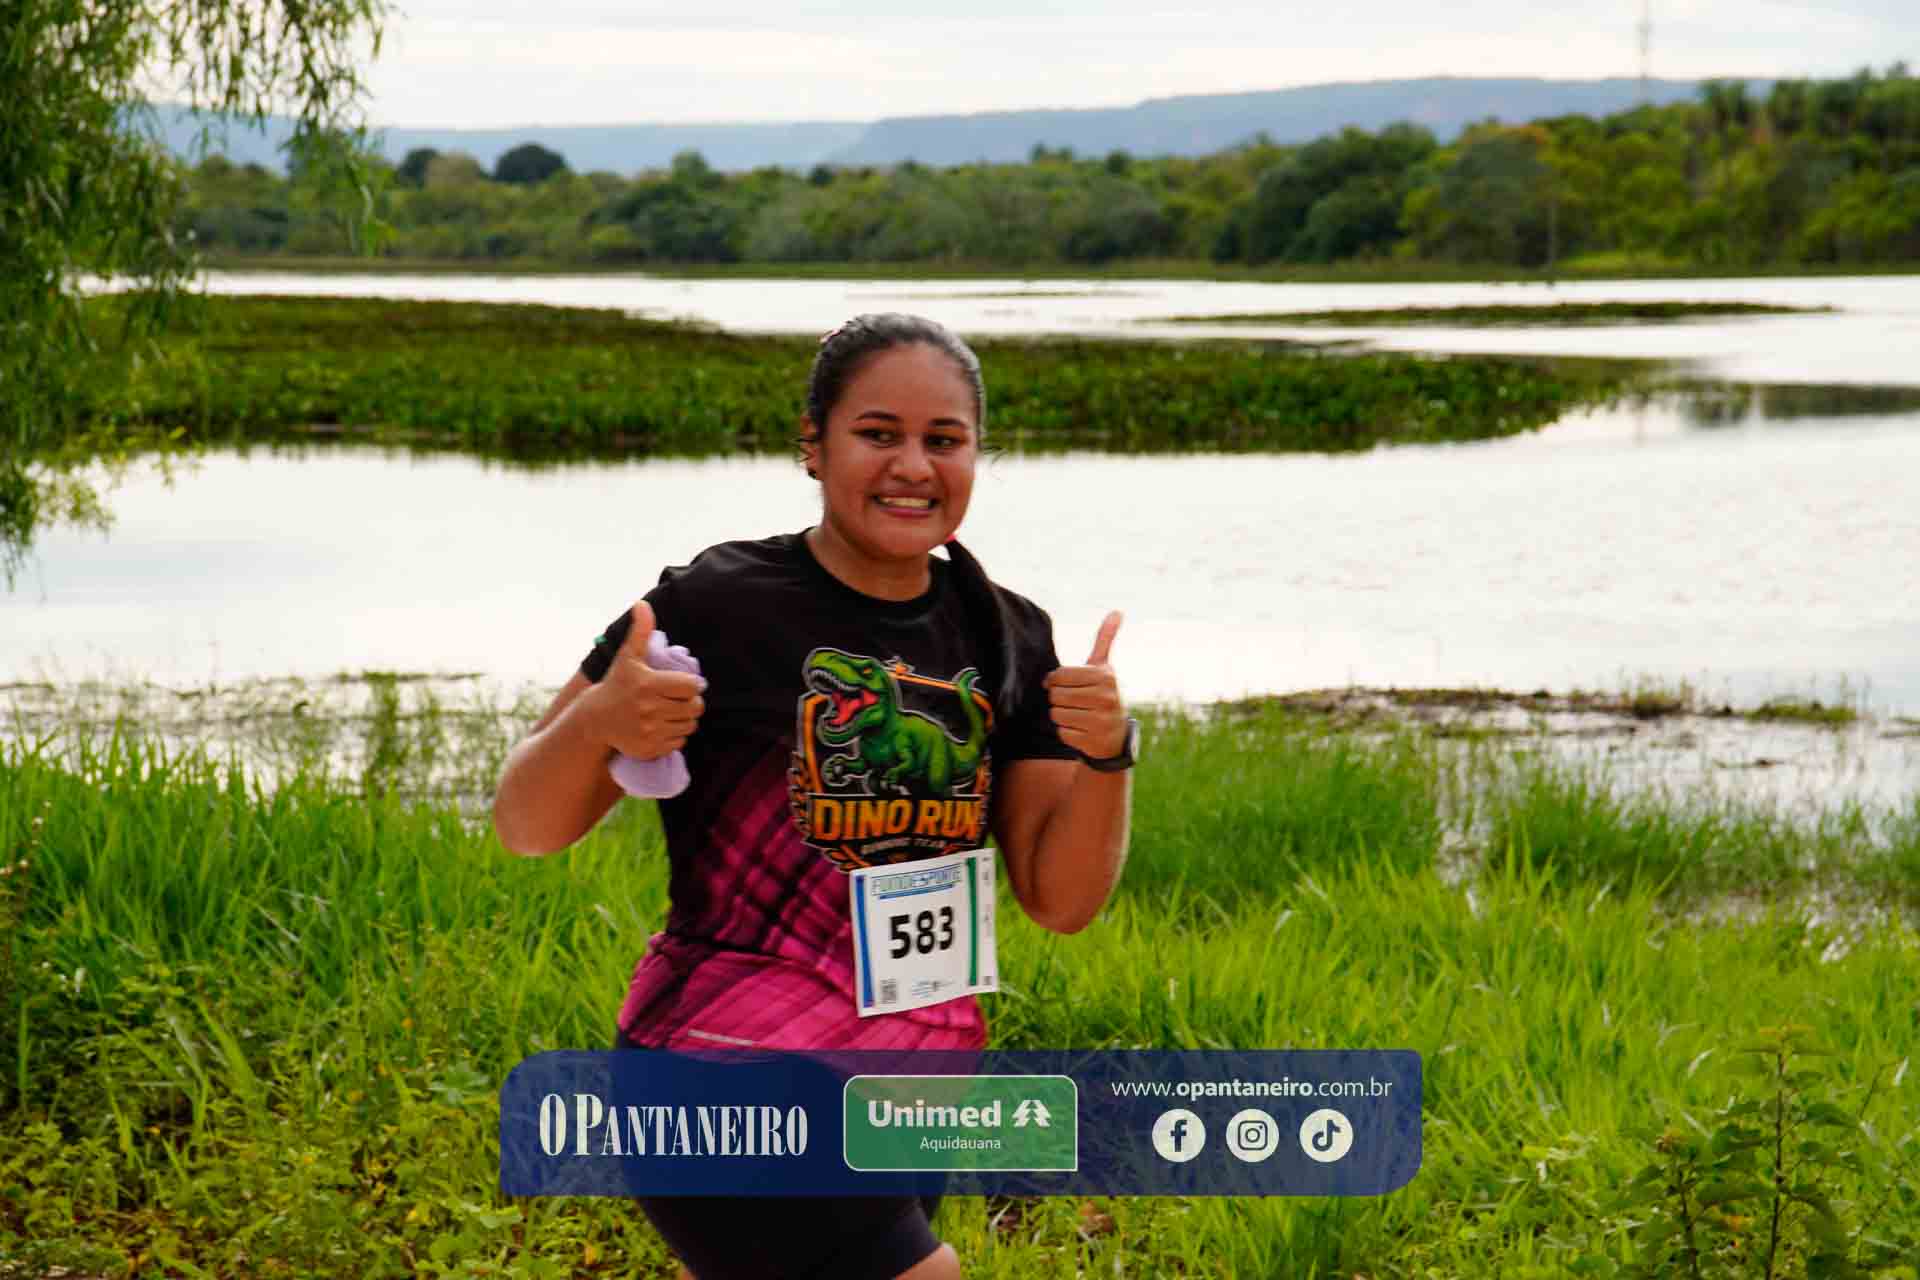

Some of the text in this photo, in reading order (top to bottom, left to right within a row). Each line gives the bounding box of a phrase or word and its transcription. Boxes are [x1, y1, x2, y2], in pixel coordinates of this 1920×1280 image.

[814, 799, 981, 841] DINO RUN
[890, 906, 953, 960] 583
